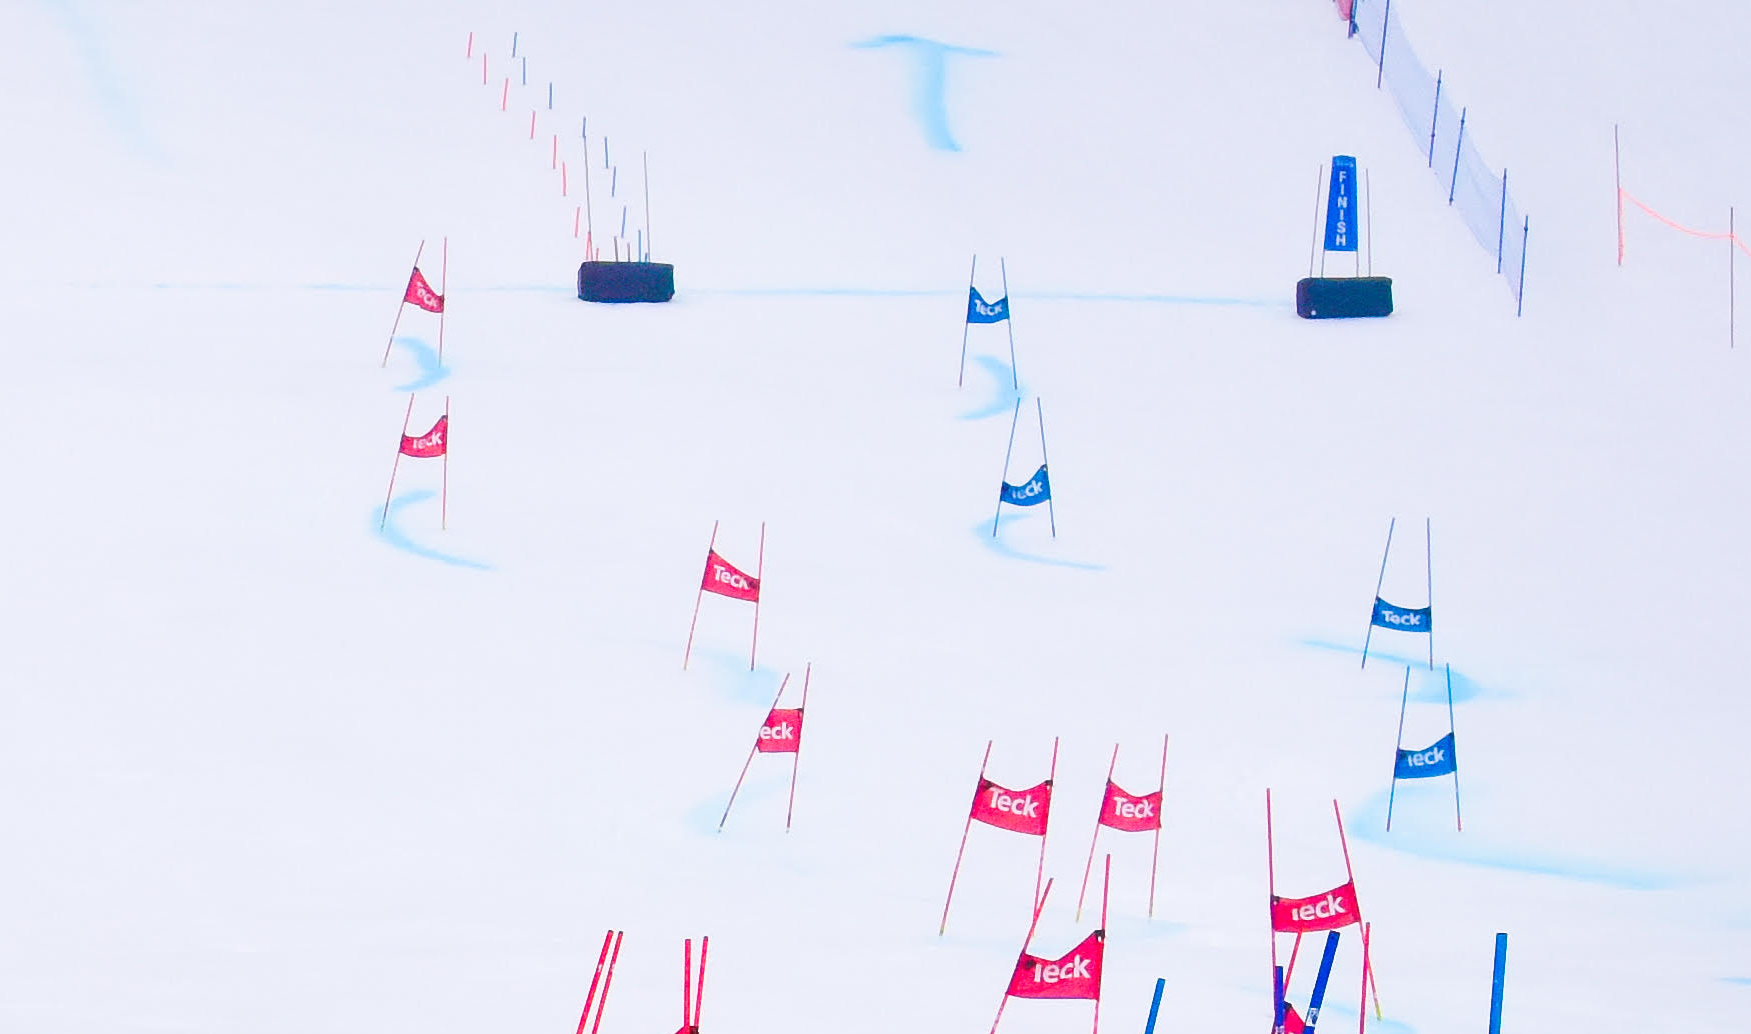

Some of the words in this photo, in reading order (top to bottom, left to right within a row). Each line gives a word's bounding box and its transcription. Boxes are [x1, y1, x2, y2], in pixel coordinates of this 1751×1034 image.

[1336, 171, 1347, 247] FINISH
[1381, 610, 1421, 625] Teck
[759, 721, 794, 740] eck
[989, 786, 1039, 818] Teck
[1113, 796, 1154, 819] Teck
